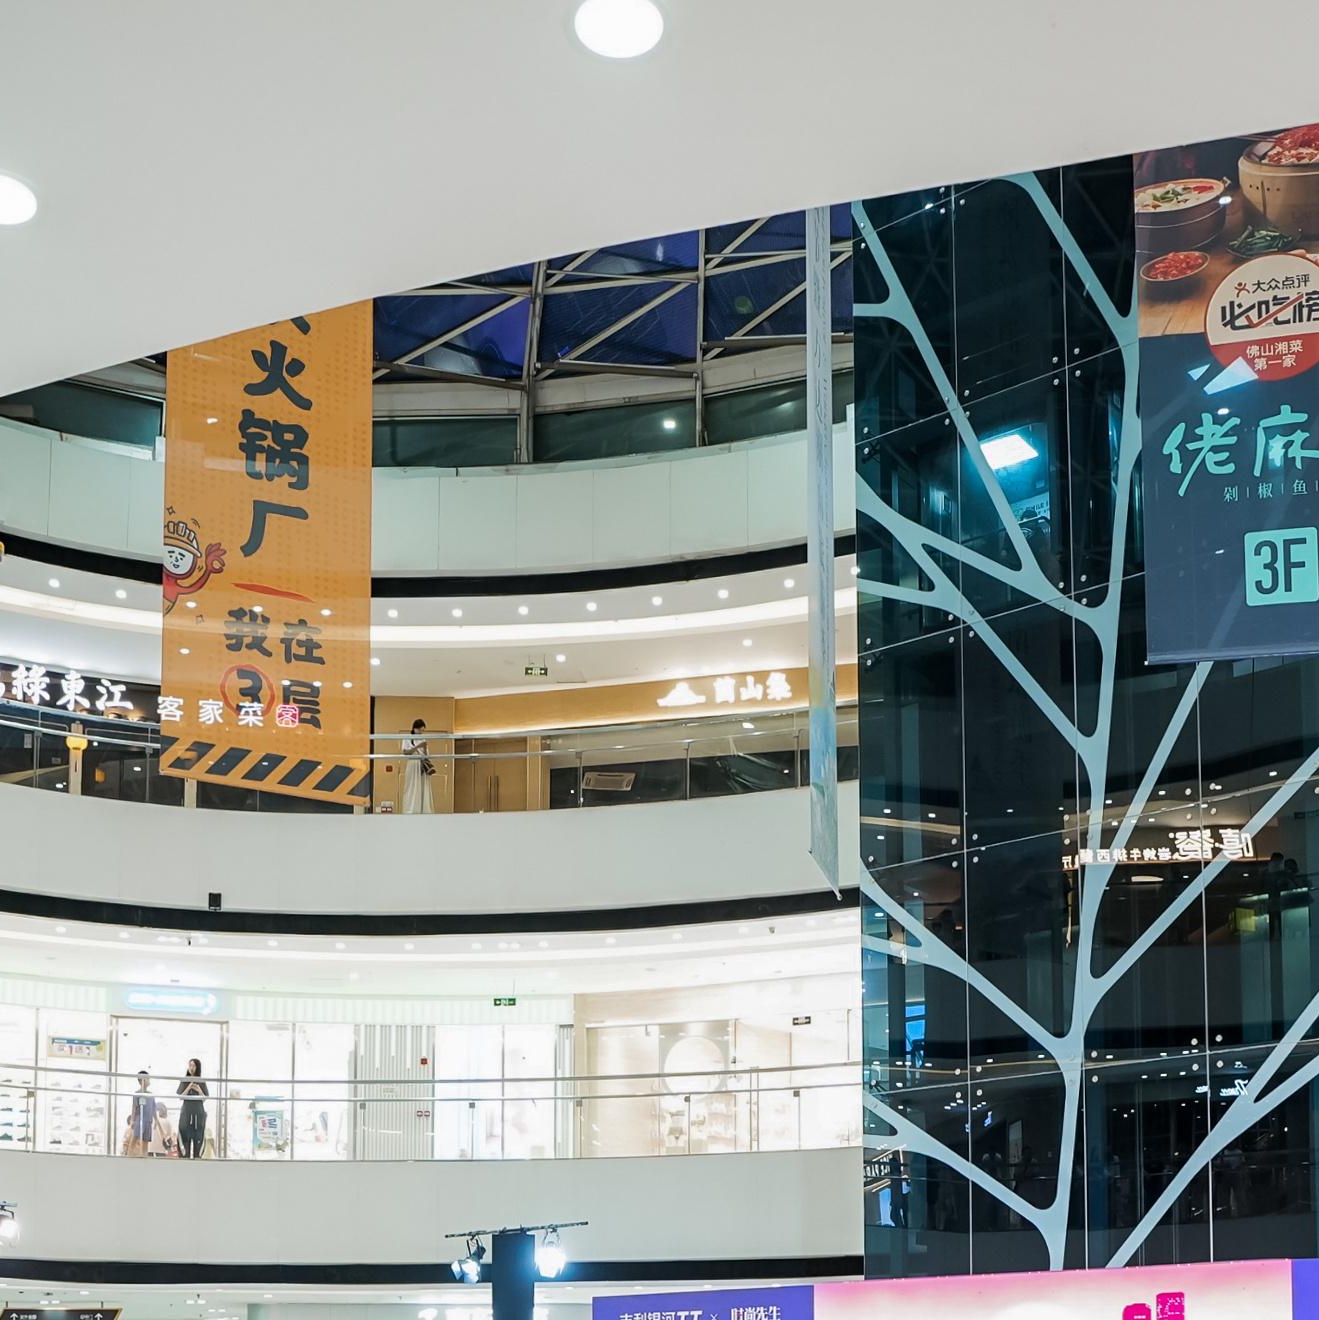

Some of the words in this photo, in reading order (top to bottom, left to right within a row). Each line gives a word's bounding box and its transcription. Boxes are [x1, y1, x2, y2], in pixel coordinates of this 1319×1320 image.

[1252, 274, 1311, 293] 大众点评
[1246, 339, 1304, 358] 佛山湘菜
[1254, 354, 1297, 371] 第一家
[238, 315, 313, 558] 火锅厂
[1254, 537, 1308, 595] 3F
[157, 695, 264, 727] 客家菜
